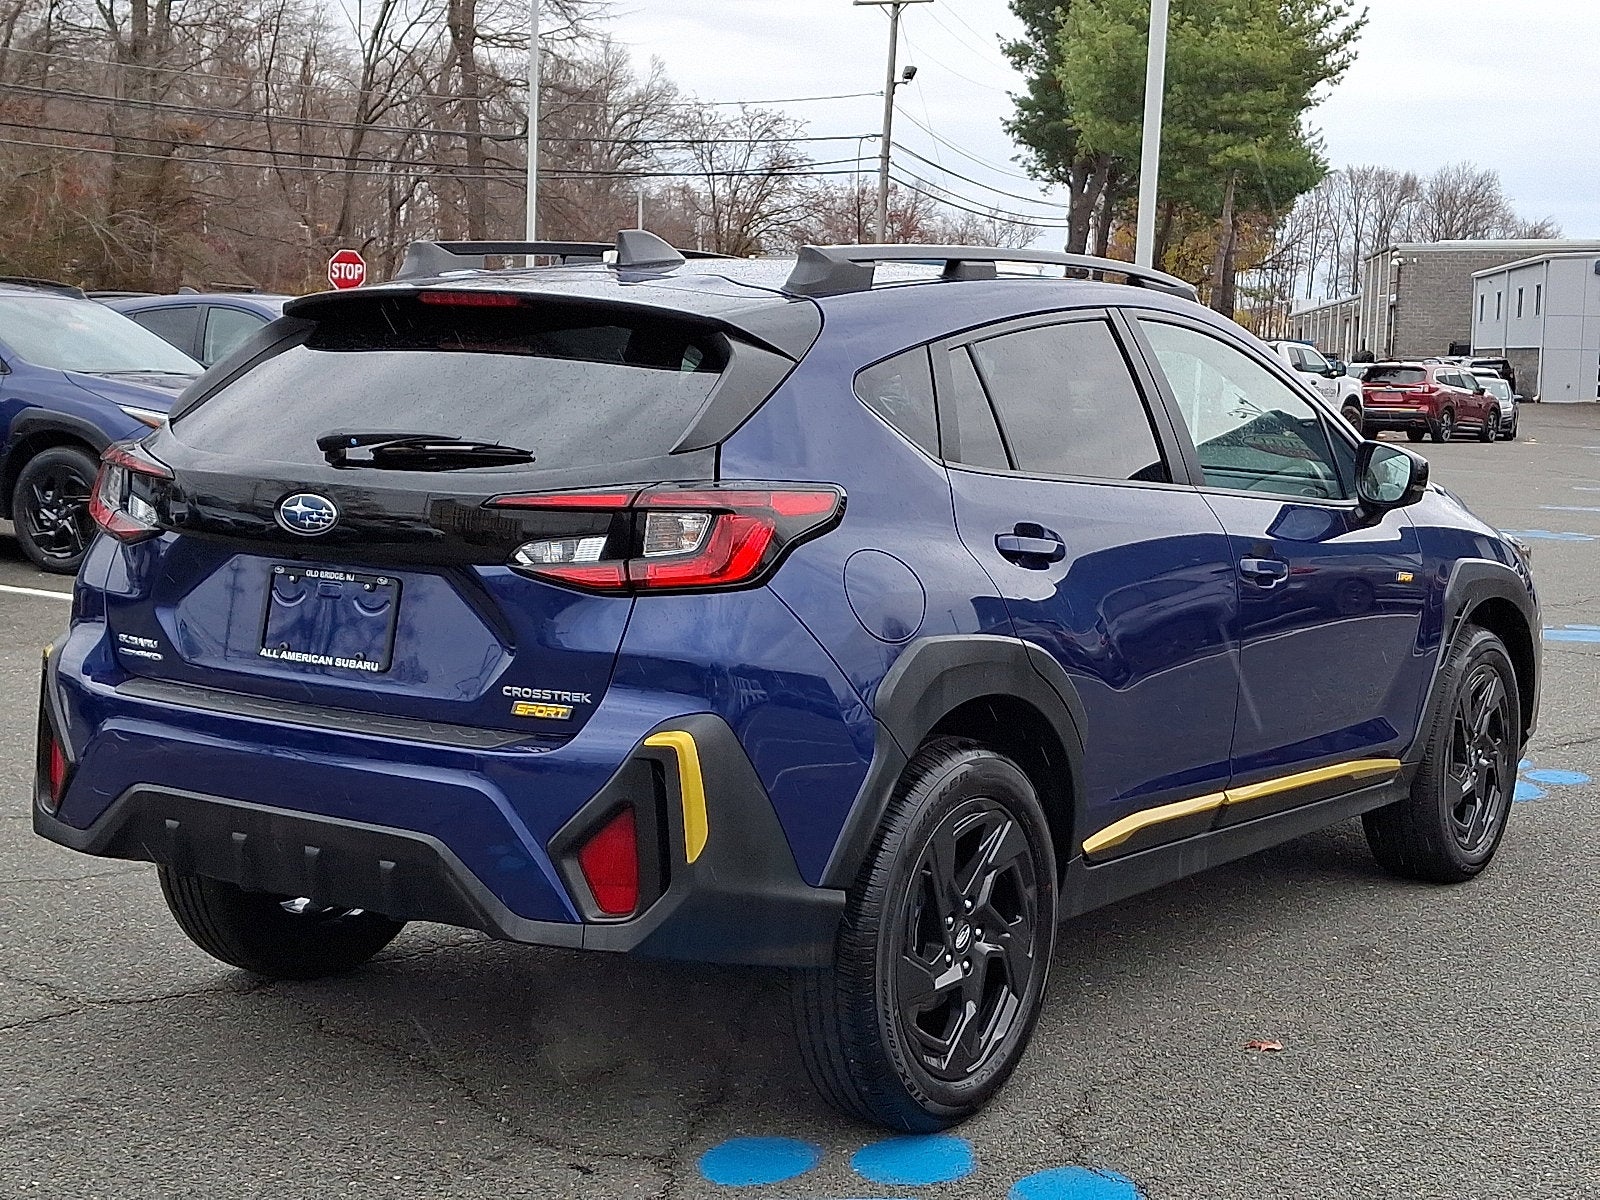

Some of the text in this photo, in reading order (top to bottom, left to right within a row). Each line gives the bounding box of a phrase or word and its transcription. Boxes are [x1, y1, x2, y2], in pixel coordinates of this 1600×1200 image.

[331, 262, 363, 280] STOP
[305, 570, 319, 578] OLD
[345, 573, 355, 582] NJ
[259, 647, 379, 672] ALL AMERICAN SUBARU
[502, 685, 592, 704] CROSSTREK
[515, 704, 568, 718] SPORT
